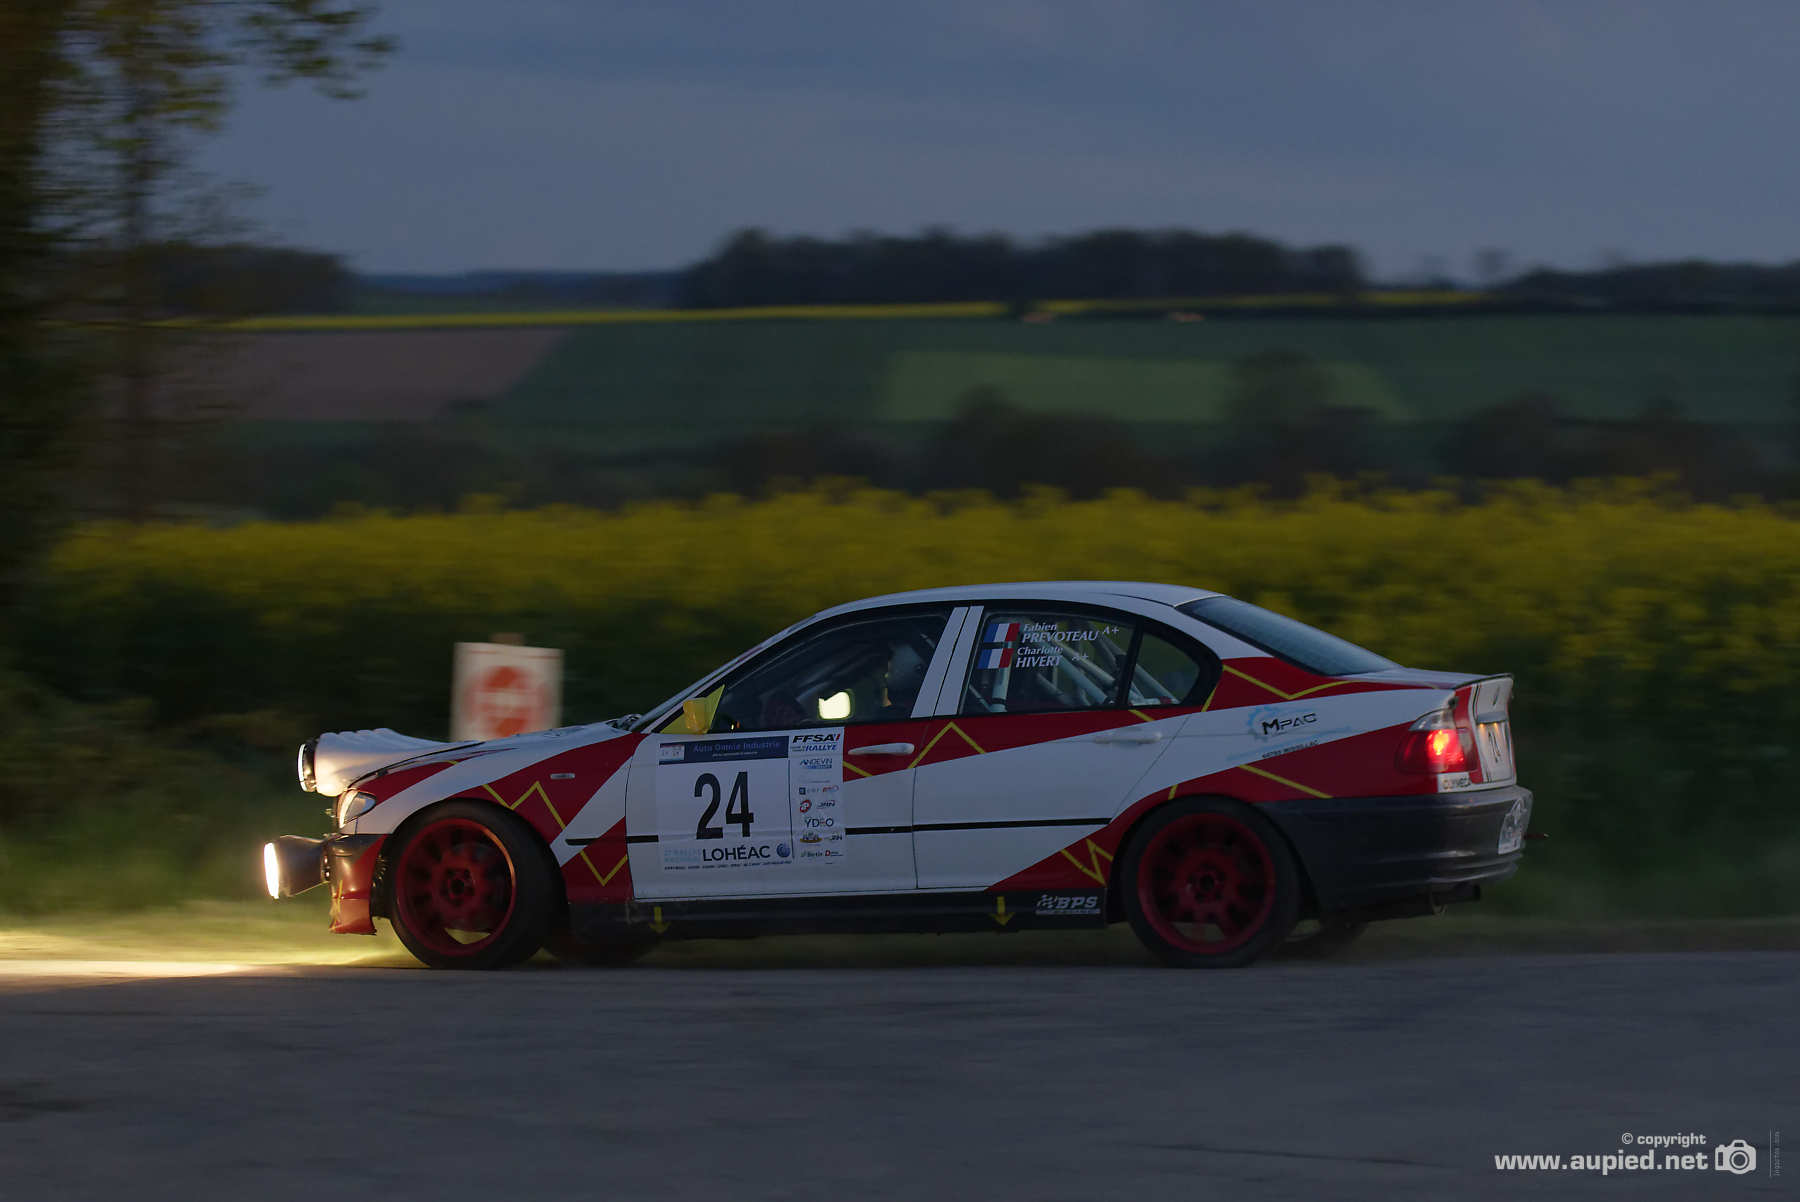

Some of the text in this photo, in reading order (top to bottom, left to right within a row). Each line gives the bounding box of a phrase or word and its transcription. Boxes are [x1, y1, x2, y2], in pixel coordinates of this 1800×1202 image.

[1021, 626, 1119, 643] PREVOTEAU A+
[1024, 622, 1057, 632] Fabien
[1015, 655, 1063, 668] HIVERT
[1262, 712, 1317, 735] MPAC
[792, 734, 835, 743] FFSA
[694, 771, 754, 839] 24
[703, 845, 771, 861] LOHÉAC
[1056, 895, 1098, 909] BPS
